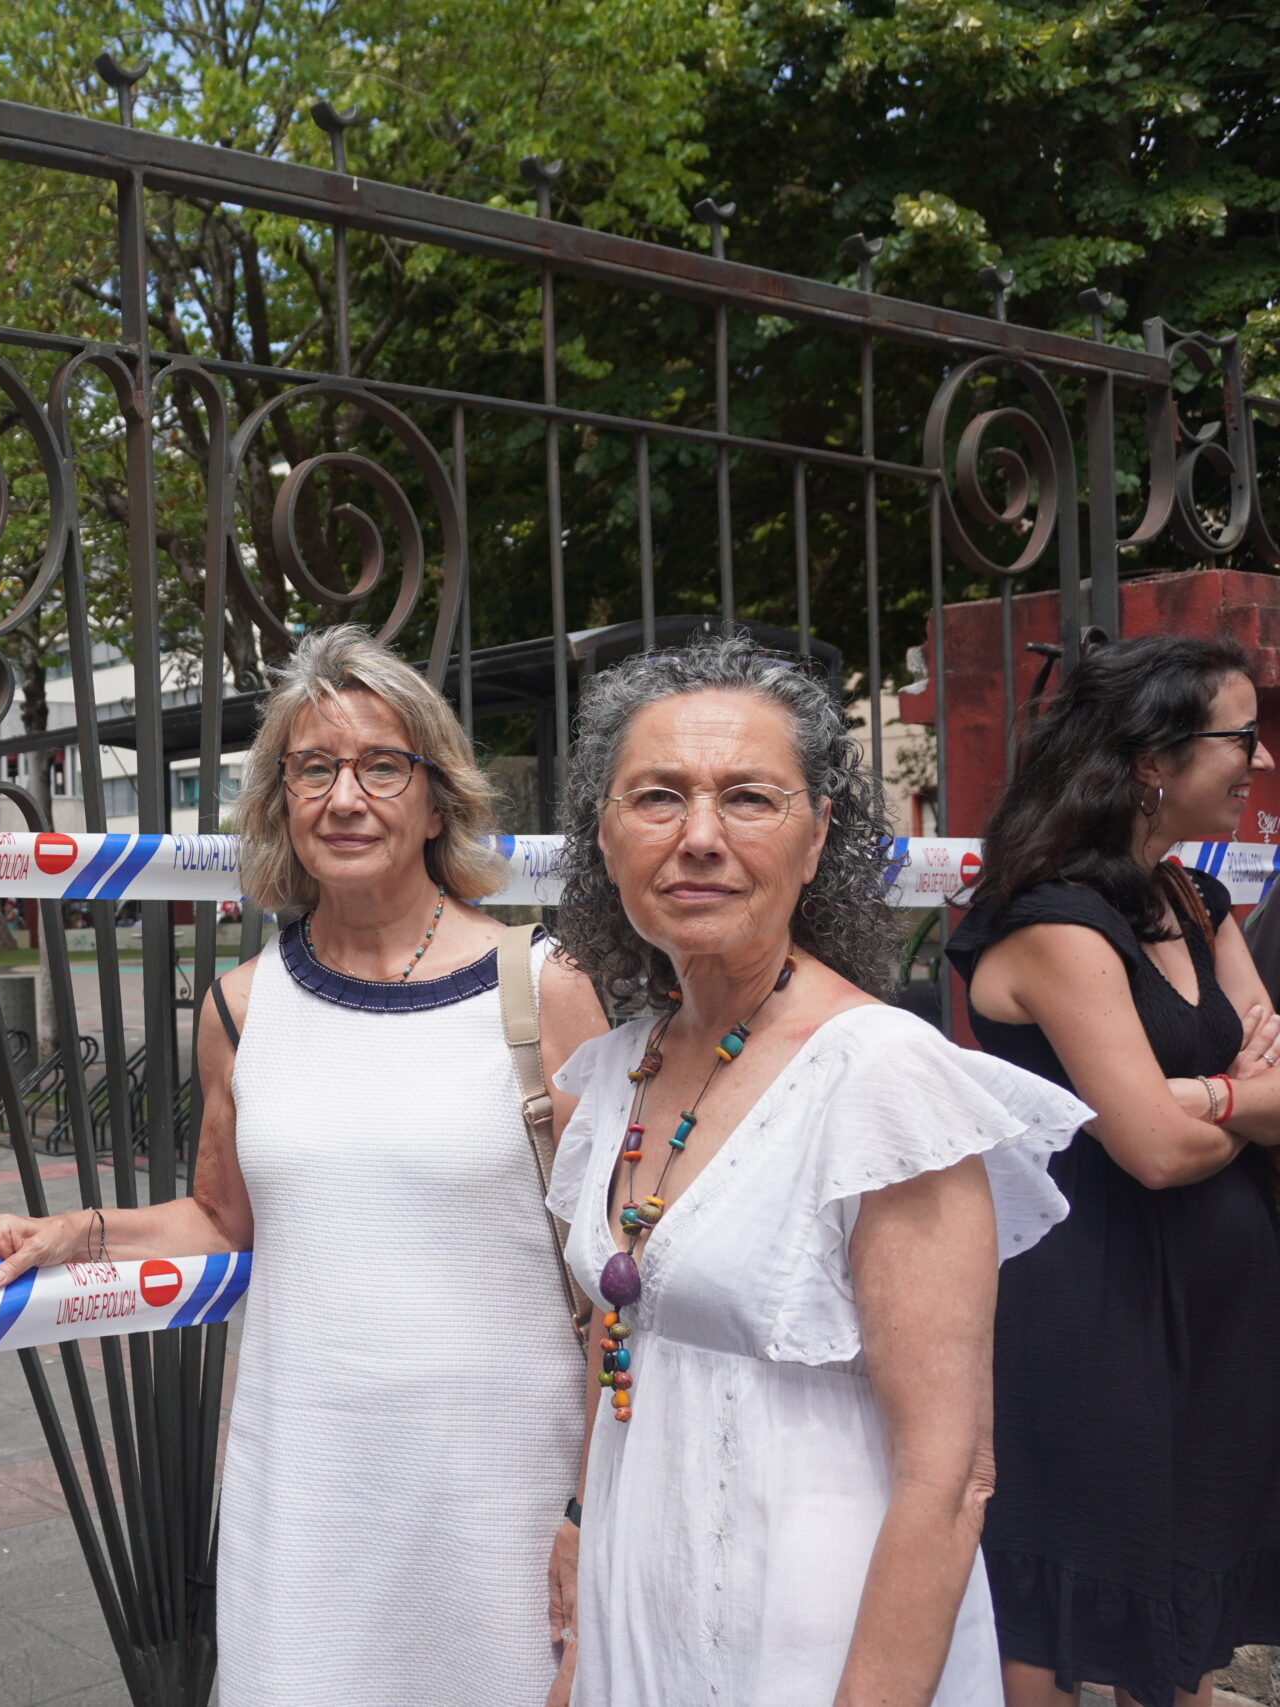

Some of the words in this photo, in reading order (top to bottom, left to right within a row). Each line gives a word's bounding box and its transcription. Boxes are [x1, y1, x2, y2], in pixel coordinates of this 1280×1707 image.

[56, 1296, 84, 1325] LINEA
[85, 1294, 101, 1321] DE
[100, 1289, 136, 1319] POLICIA
